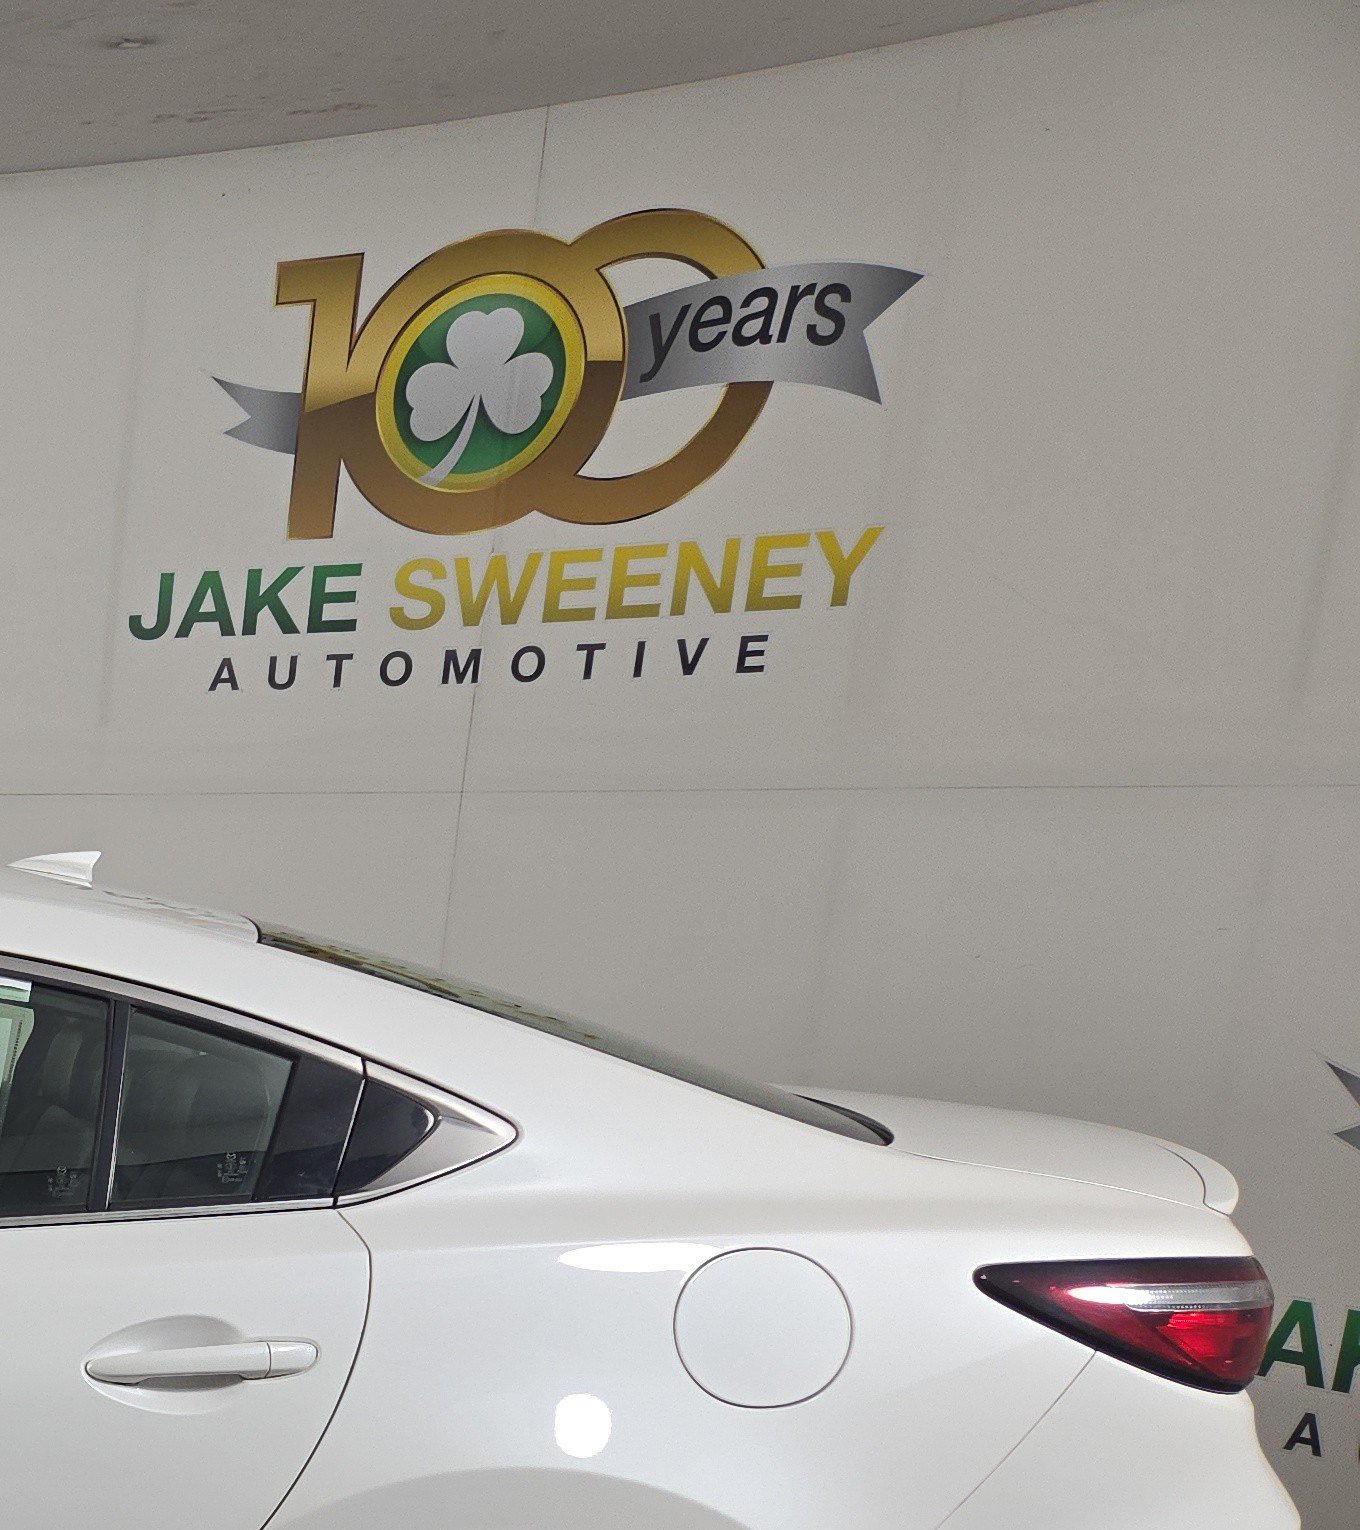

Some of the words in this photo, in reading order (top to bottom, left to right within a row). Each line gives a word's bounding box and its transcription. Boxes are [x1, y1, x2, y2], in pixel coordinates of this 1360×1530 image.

[638, 279, 852, 383] years
[128, 562, 363, 642] JAKE
[388, 526, 885, 632] SWEENEY
[209, 634, 770, 693] AUTOMOTIVE
